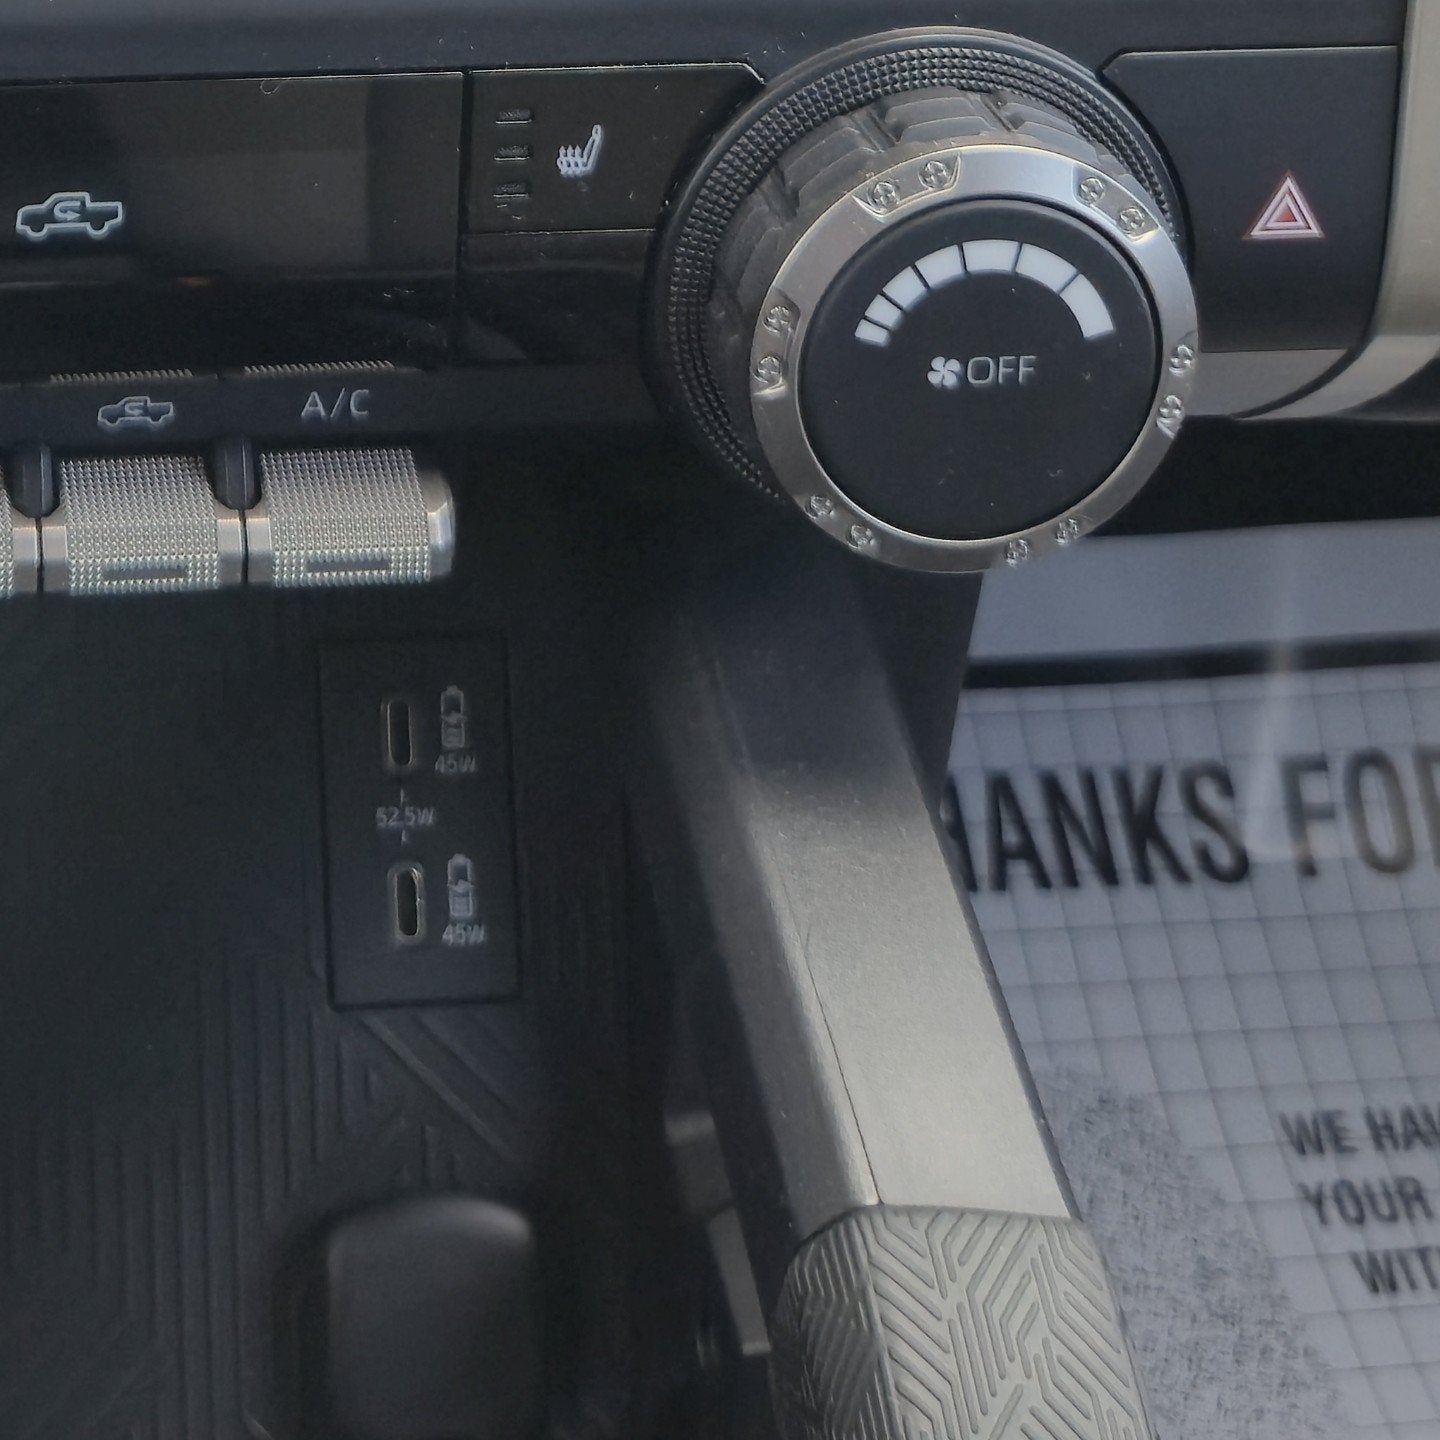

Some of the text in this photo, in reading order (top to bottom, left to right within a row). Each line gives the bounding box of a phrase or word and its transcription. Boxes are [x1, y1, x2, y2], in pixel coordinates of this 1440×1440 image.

[966, 355, 1037, 387] OFF
[301, 389, 371, 419] A/C
[1279, 1108, 1359, 1156] WE
[1297, 1175, 1433, 1225] YOUR
